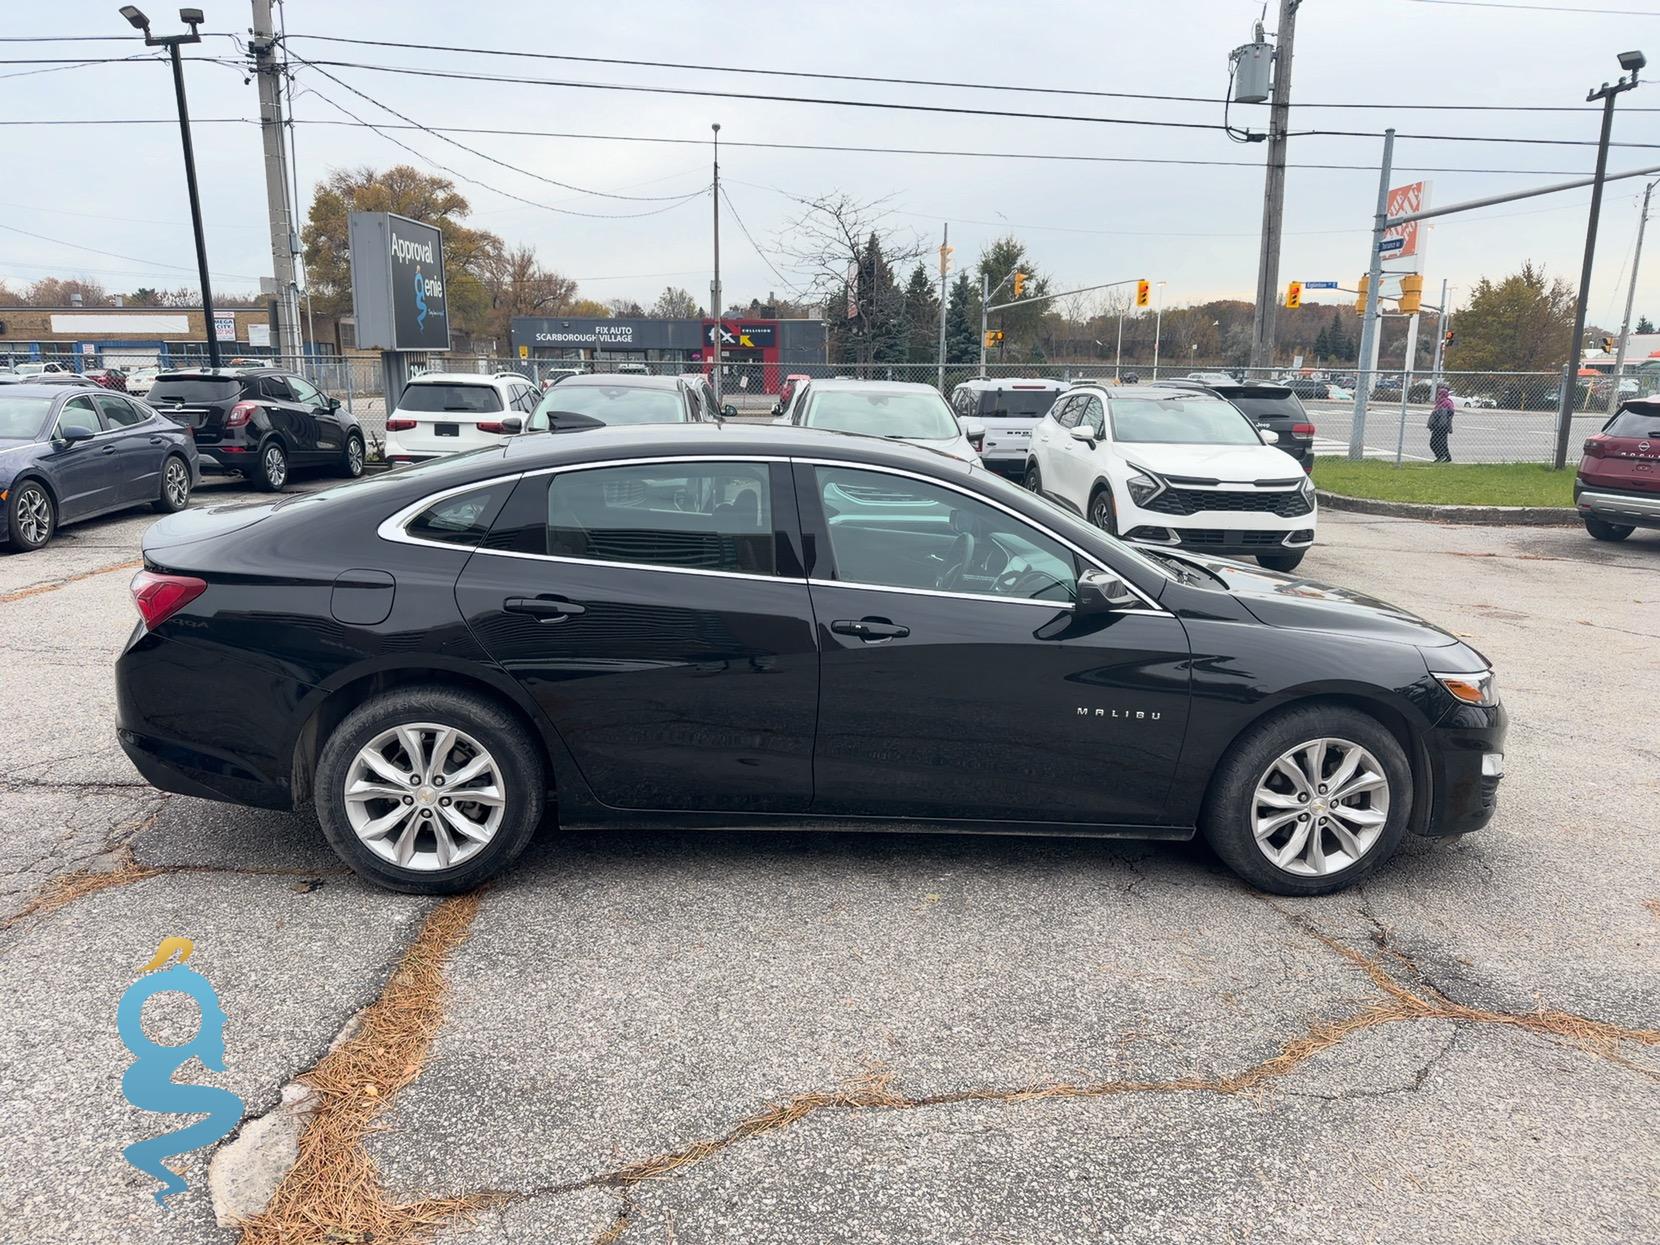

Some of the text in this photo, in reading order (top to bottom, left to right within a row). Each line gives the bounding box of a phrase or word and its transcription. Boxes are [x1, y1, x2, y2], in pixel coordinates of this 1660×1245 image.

[391, 232, 434, 264] Approval
[595, 326, 633, 335] FIX AUTO
[535, 333, 633, 343] SCARBOROUGH VILLAGE
[1076, 707, 1161, 720] MALIBU
